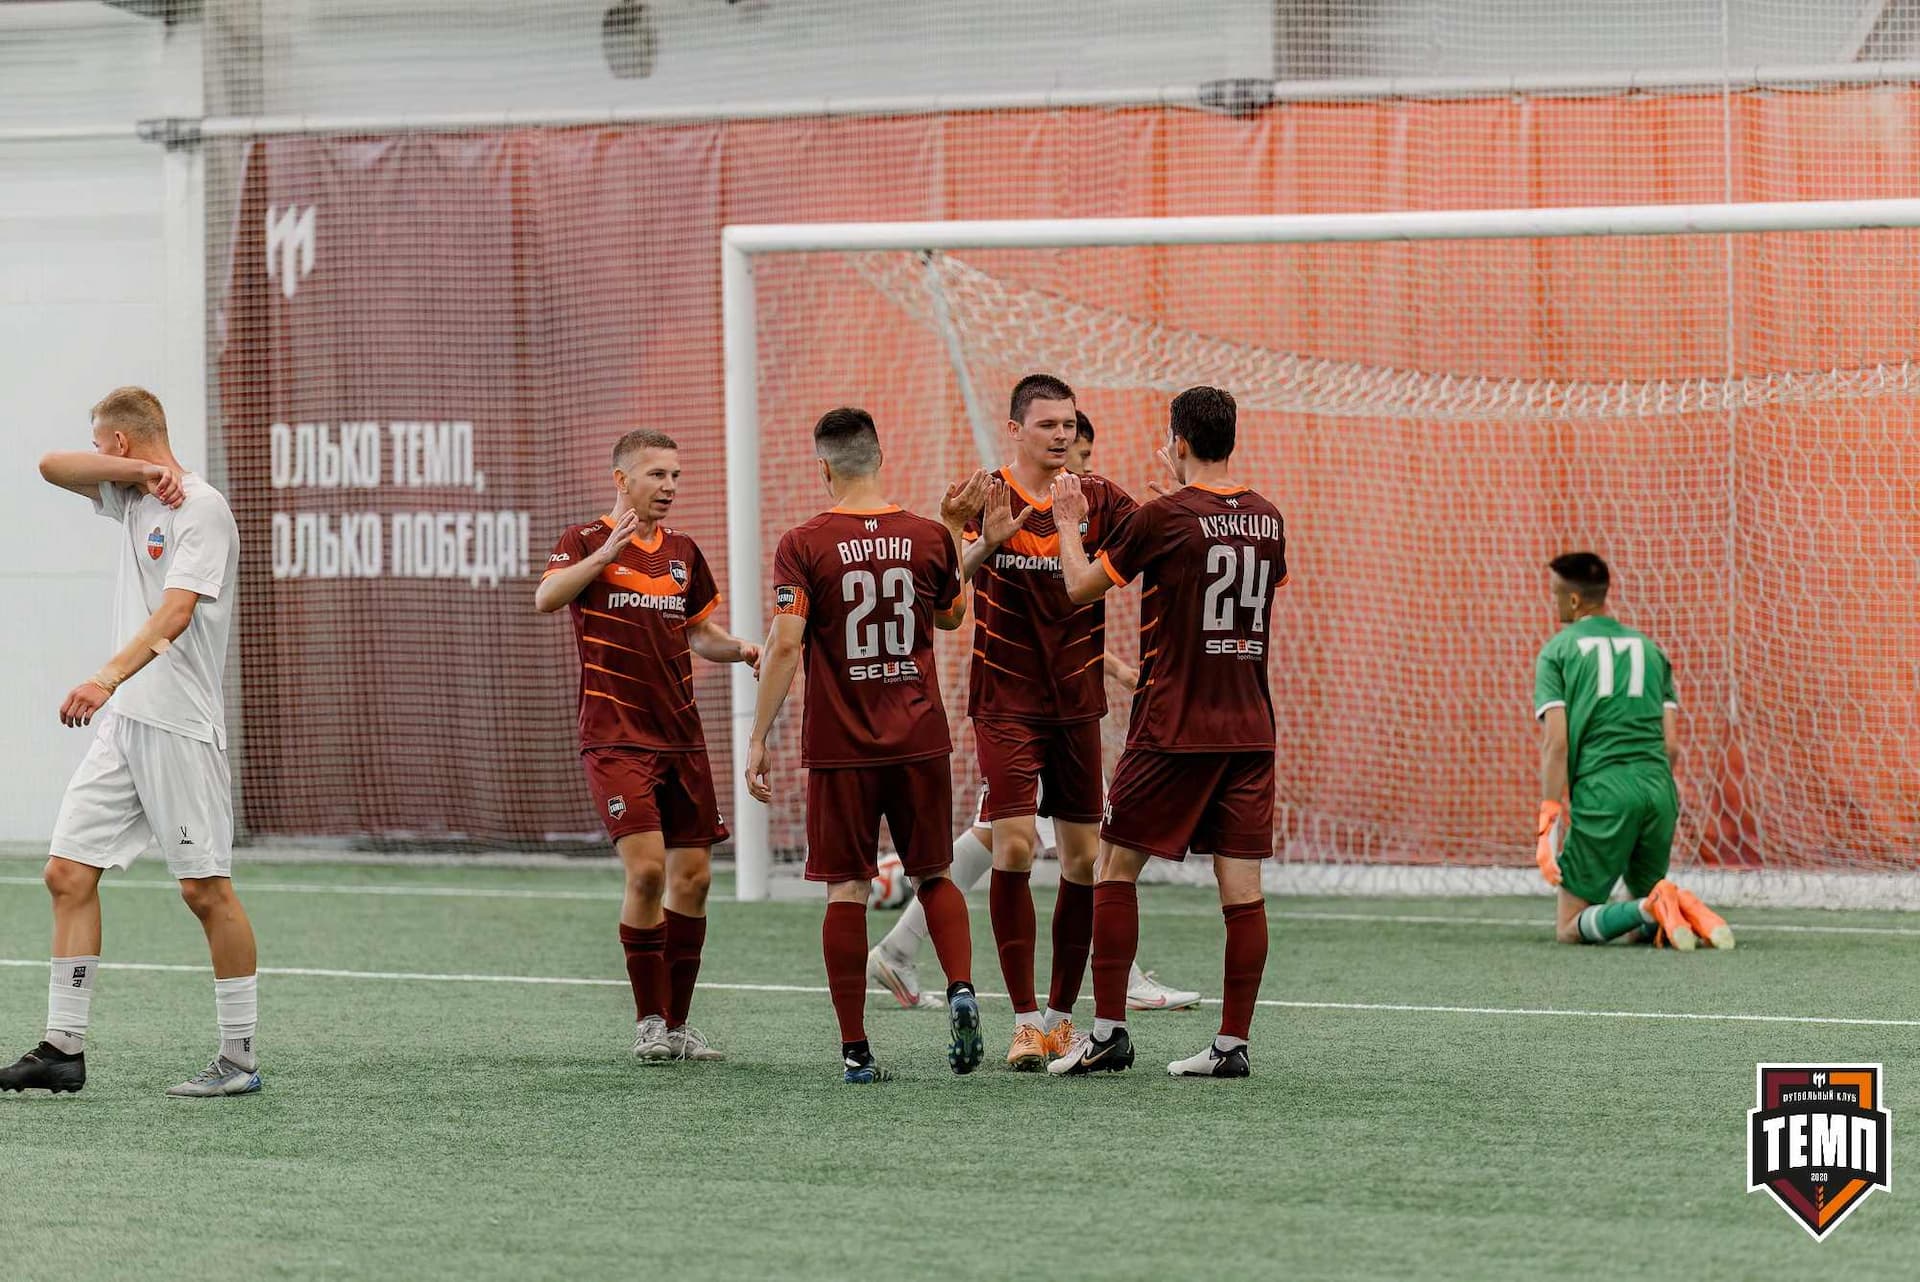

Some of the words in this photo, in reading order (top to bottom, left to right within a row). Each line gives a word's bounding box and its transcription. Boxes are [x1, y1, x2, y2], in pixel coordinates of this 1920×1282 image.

[389, 422, 485, 494] ТЕМП,
[391, 511, 530, 589] ПОБЕДА!
[837, 537, 912, 565] ВОРОНА
[1198, 514, 1279, 541] КУЗНЕЦОВ
[842, 567, 916, 659] 23
[1203, 544, 1270, 632] 24
[849, 661, 919, 681] SEUS
[1205, 639, 1264, 655] SEUS
[1577, 637, 1645, 697] 77
